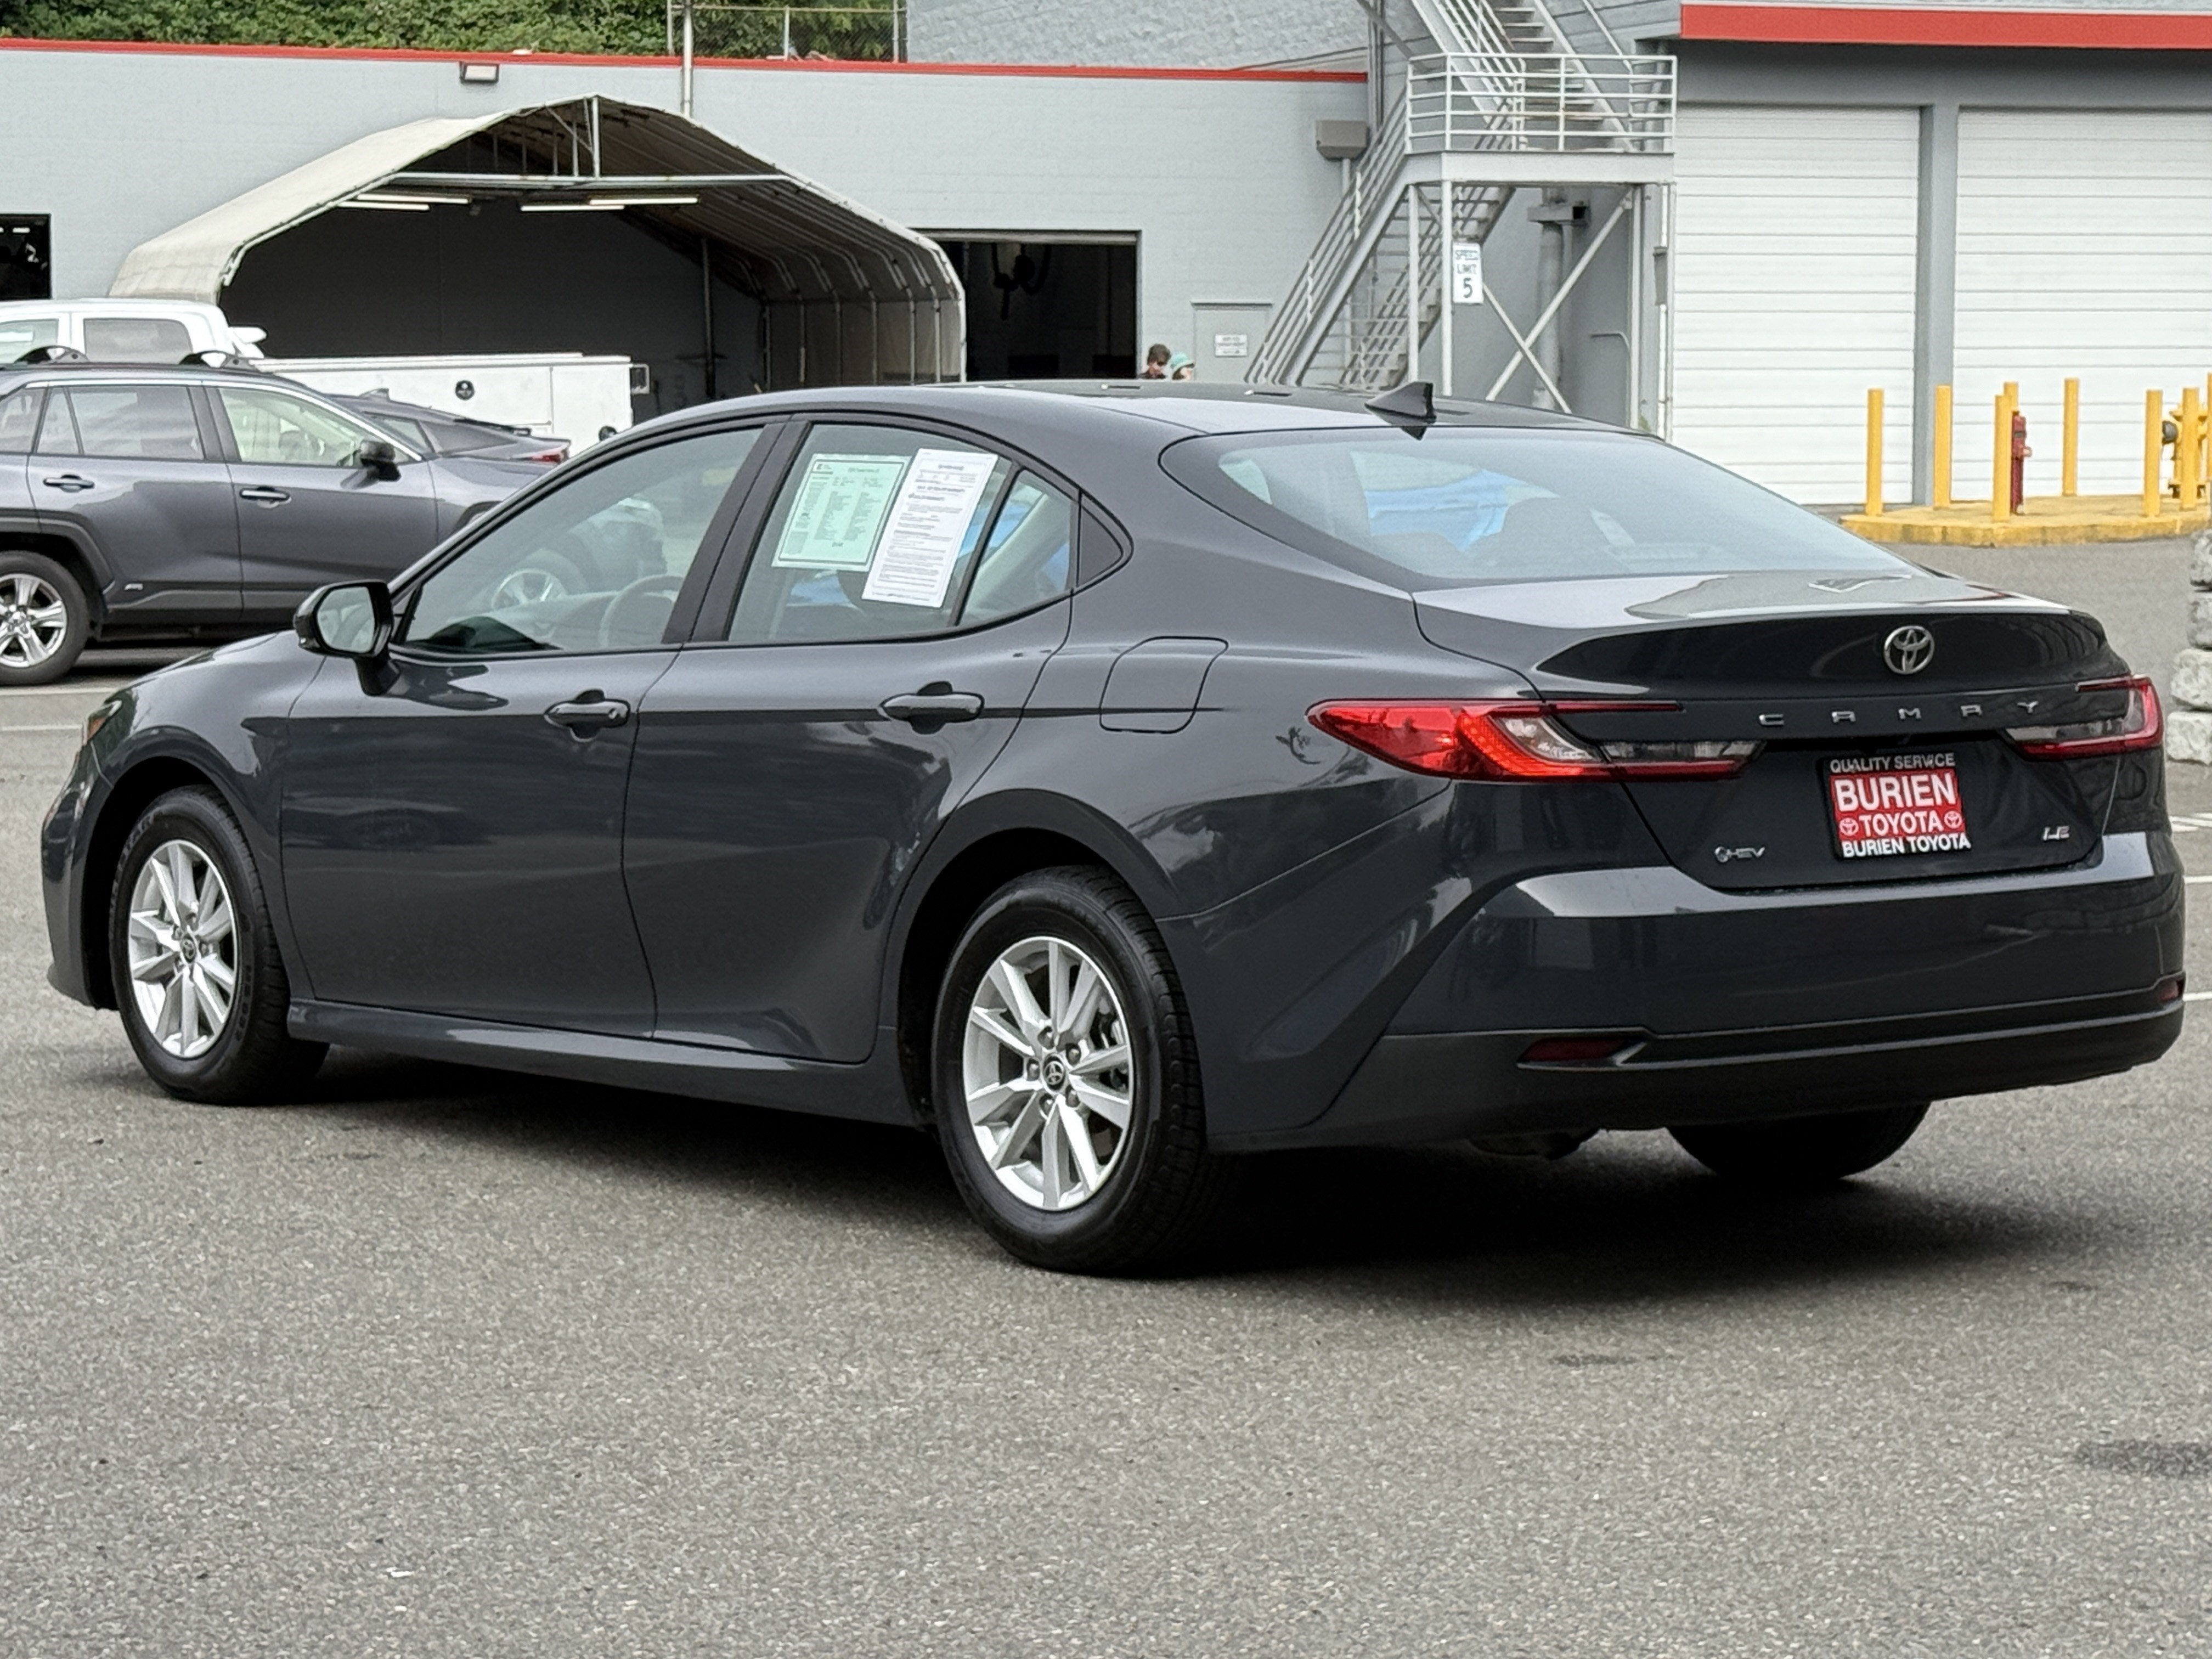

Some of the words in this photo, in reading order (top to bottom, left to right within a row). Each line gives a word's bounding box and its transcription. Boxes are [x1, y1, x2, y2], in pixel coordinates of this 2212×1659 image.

[1463, 277, 1473, 298] 5
[1758, 700, 2039, 726] CAMRY
[1830, 757, 1891, 774] QUALITY
[1894, 752, 1956, 769] SERVICE
[1835, 772, 1956, 812] BURIEN
[1858, 810, 1944, 837] TOYOTA
[2043, 825, 2070, 841] LE
[1842, 837, 1906, 858] BURIEN
[1906, 832, 1972, 853] TOYOTA
